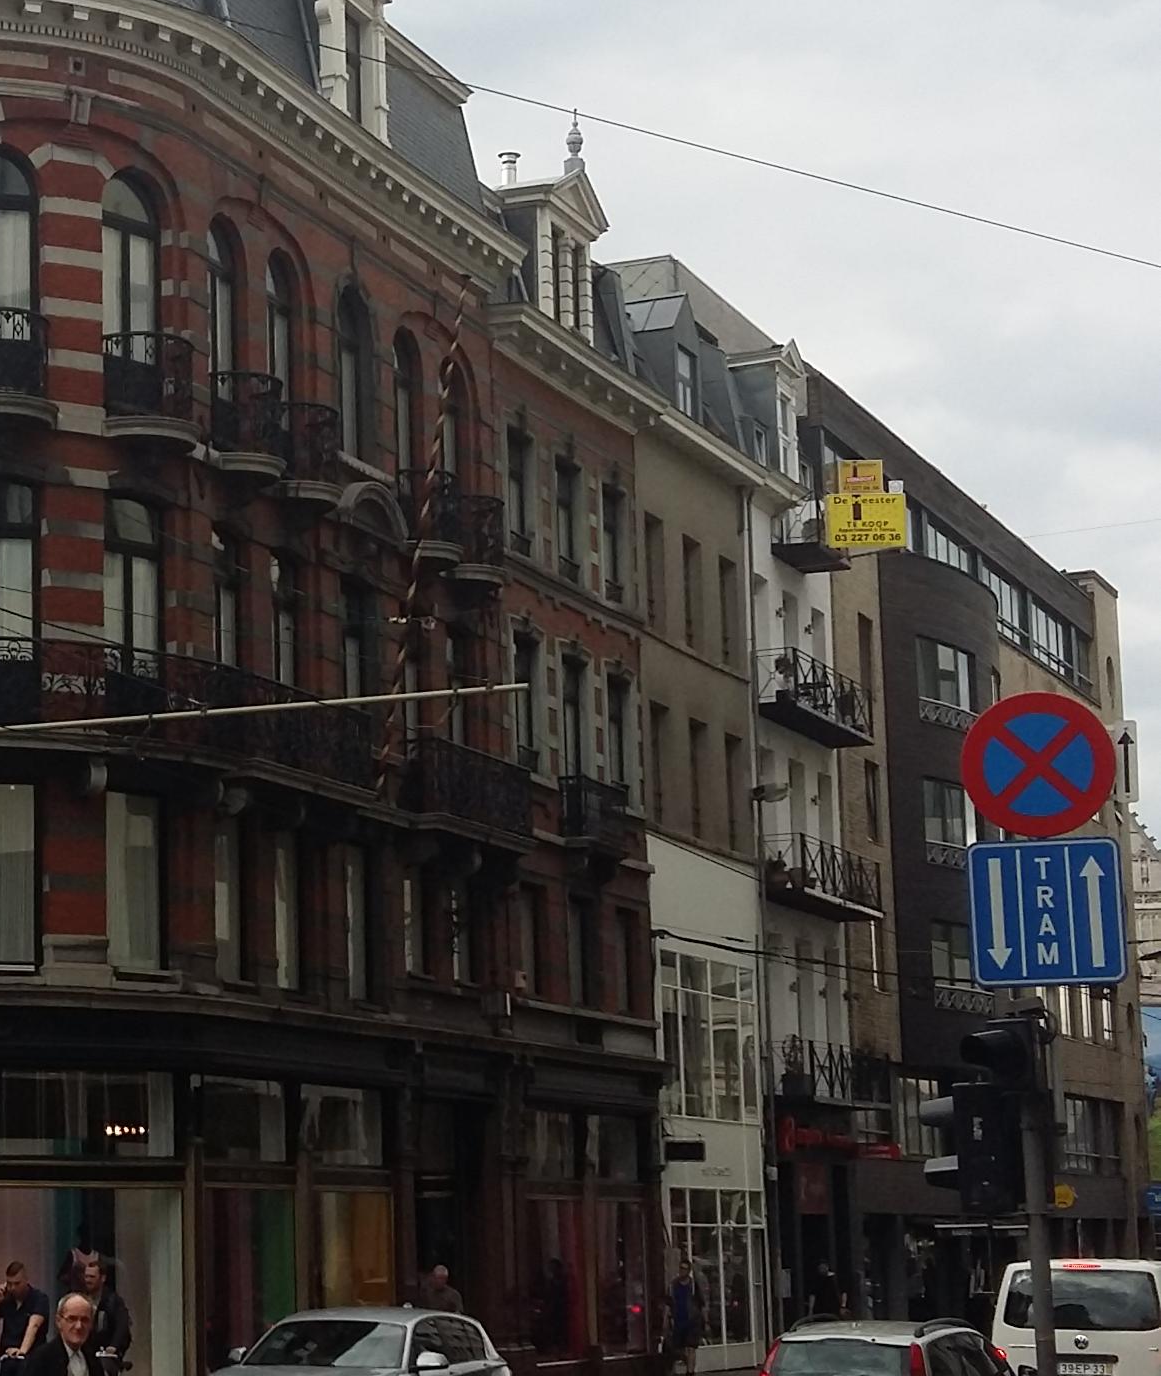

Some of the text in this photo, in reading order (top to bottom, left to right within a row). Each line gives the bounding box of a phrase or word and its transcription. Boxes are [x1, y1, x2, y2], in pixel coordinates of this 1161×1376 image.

[833, 496, 848, 505] De
[861, 520, 889, 528] KOOP
[834, 533, 902, 542] 03 227 06 36
[1033, 856, 1060, 966] TRAM
